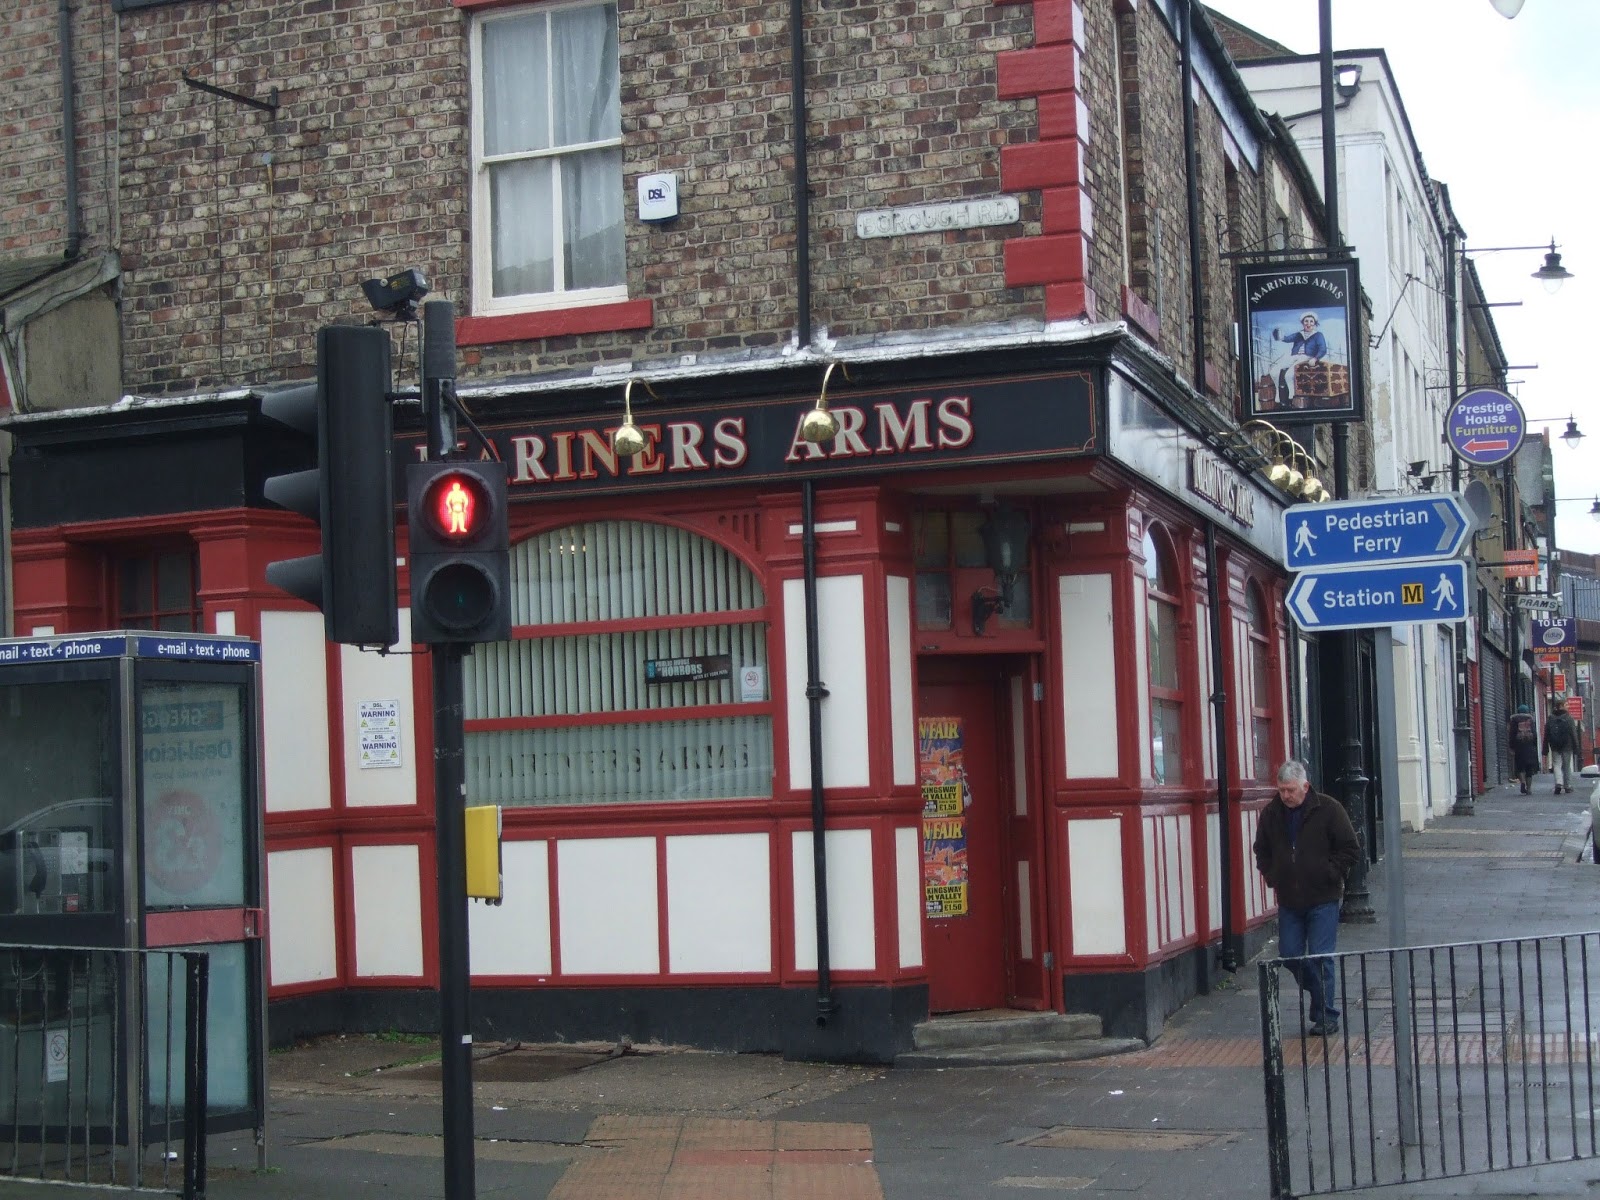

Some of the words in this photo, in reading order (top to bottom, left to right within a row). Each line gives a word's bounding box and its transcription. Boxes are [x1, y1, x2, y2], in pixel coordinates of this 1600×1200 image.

[648, 188, 666, 200] DSL
[862, 205, 970, 236] BOROUGH
[1250, 276, 1308, 304] MARINERS
[1312, 278, 1344, 300] ARMS
[1458, 402, 1512, 414] Prestige
[1465, 414, 1506, 426] House
[1456, 424, 1518, 436] Furniture
[415, 416, 747, 488] RINERS
[784, 396, 974, 464] ARMS
[1325, 508, 1428, 532] Pedestrian
[1353, 535, 1402, 554] Ferry
[1323, 588, 1394, 608] Station
[1403, 584, 1422, 604] M
[1518, 598, 1556, 608] PRAMS
[1552, 618, 1568, 626] LET
[30, 646, 54, 658] text
[65, 642, 101, 658] phone
[158, 642, 186, 654] e-mail
[196, 644, 214, 656] text
[222, 644, 250, 660] phone
[662, 664, 702, 677] HORRORS
[929, 720, 960, 739] FAIR
[932, 820, 964, 840] FAIR
[927, 886, 962, 894] KINGSWAY
